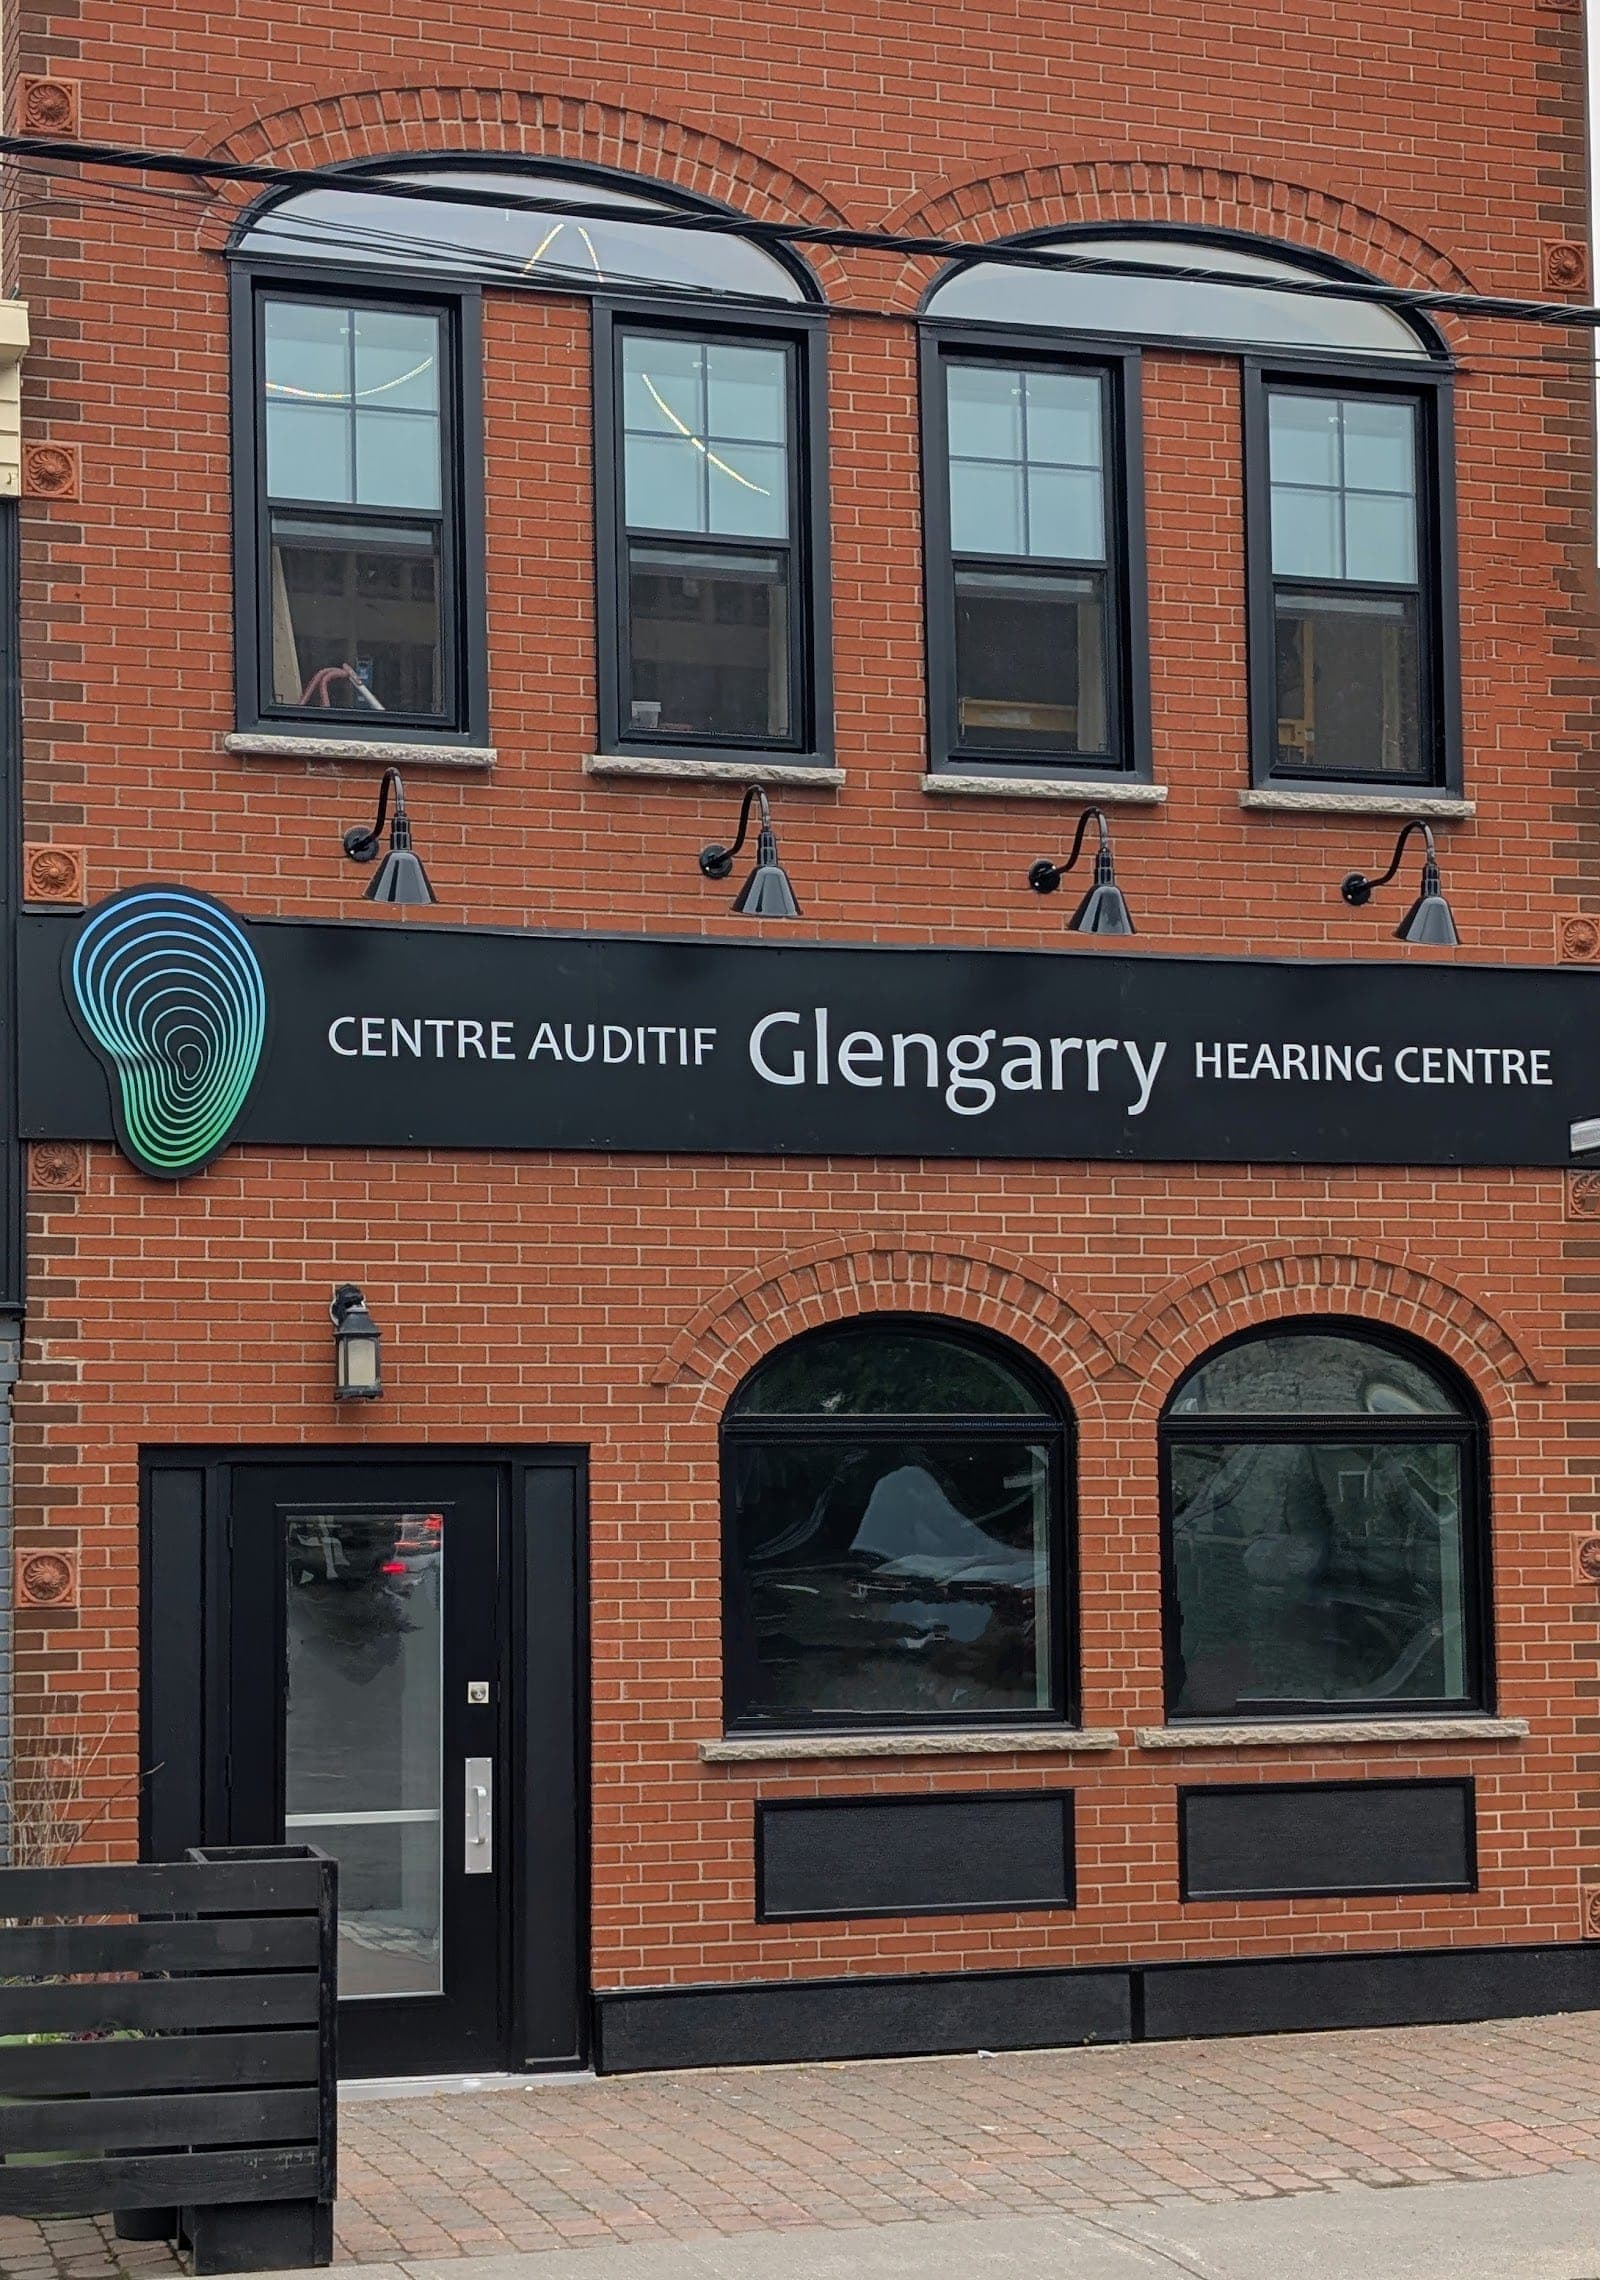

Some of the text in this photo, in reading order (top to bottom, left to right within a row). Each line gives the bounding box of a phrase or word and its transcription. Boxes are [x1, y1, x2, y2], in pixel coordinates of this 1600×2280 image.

[328, 1007, 1554, 1117] CENTRE AUDITIF Glengarry HEARING CENTRE
